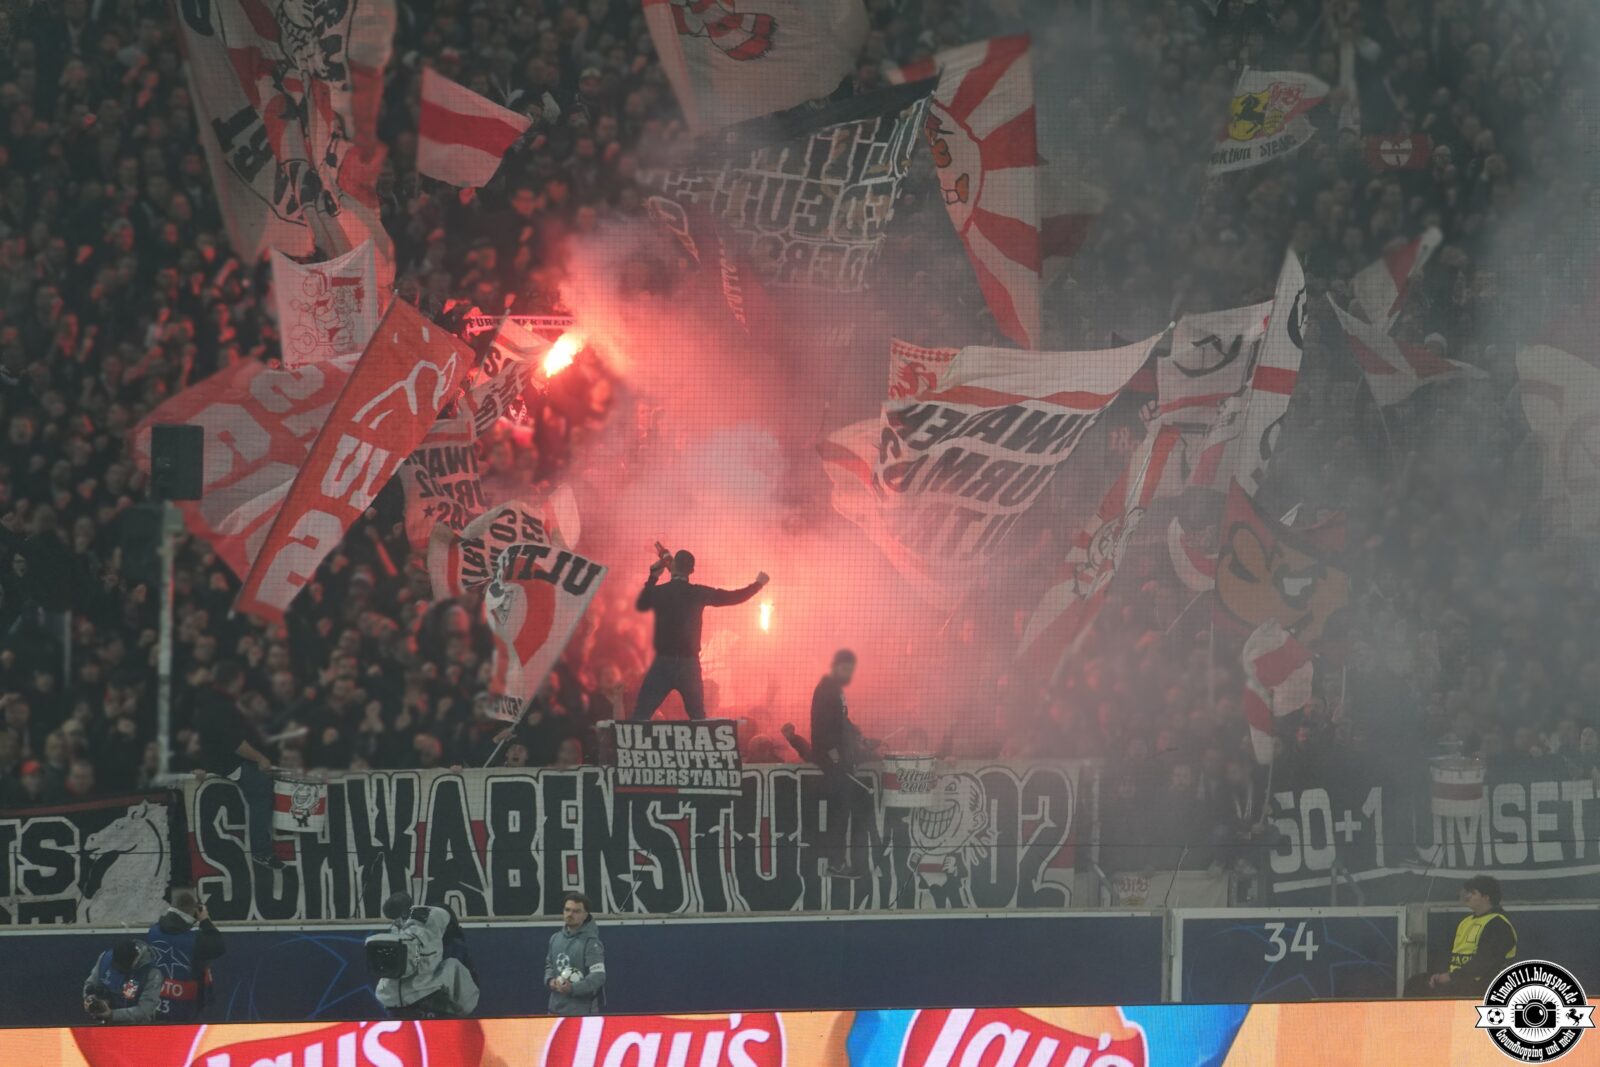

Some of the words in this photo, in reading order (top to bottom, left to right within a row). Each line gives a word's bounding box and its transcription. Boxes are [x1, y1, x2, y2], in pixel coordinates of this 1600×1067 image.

[615, 724, 736, 750] ULTRAS
[617, 749, 738, 769] BEDEUTET
[617, 768, 742, 787] WIDERSTAND
[1264, 922, 1319, 962] 34
